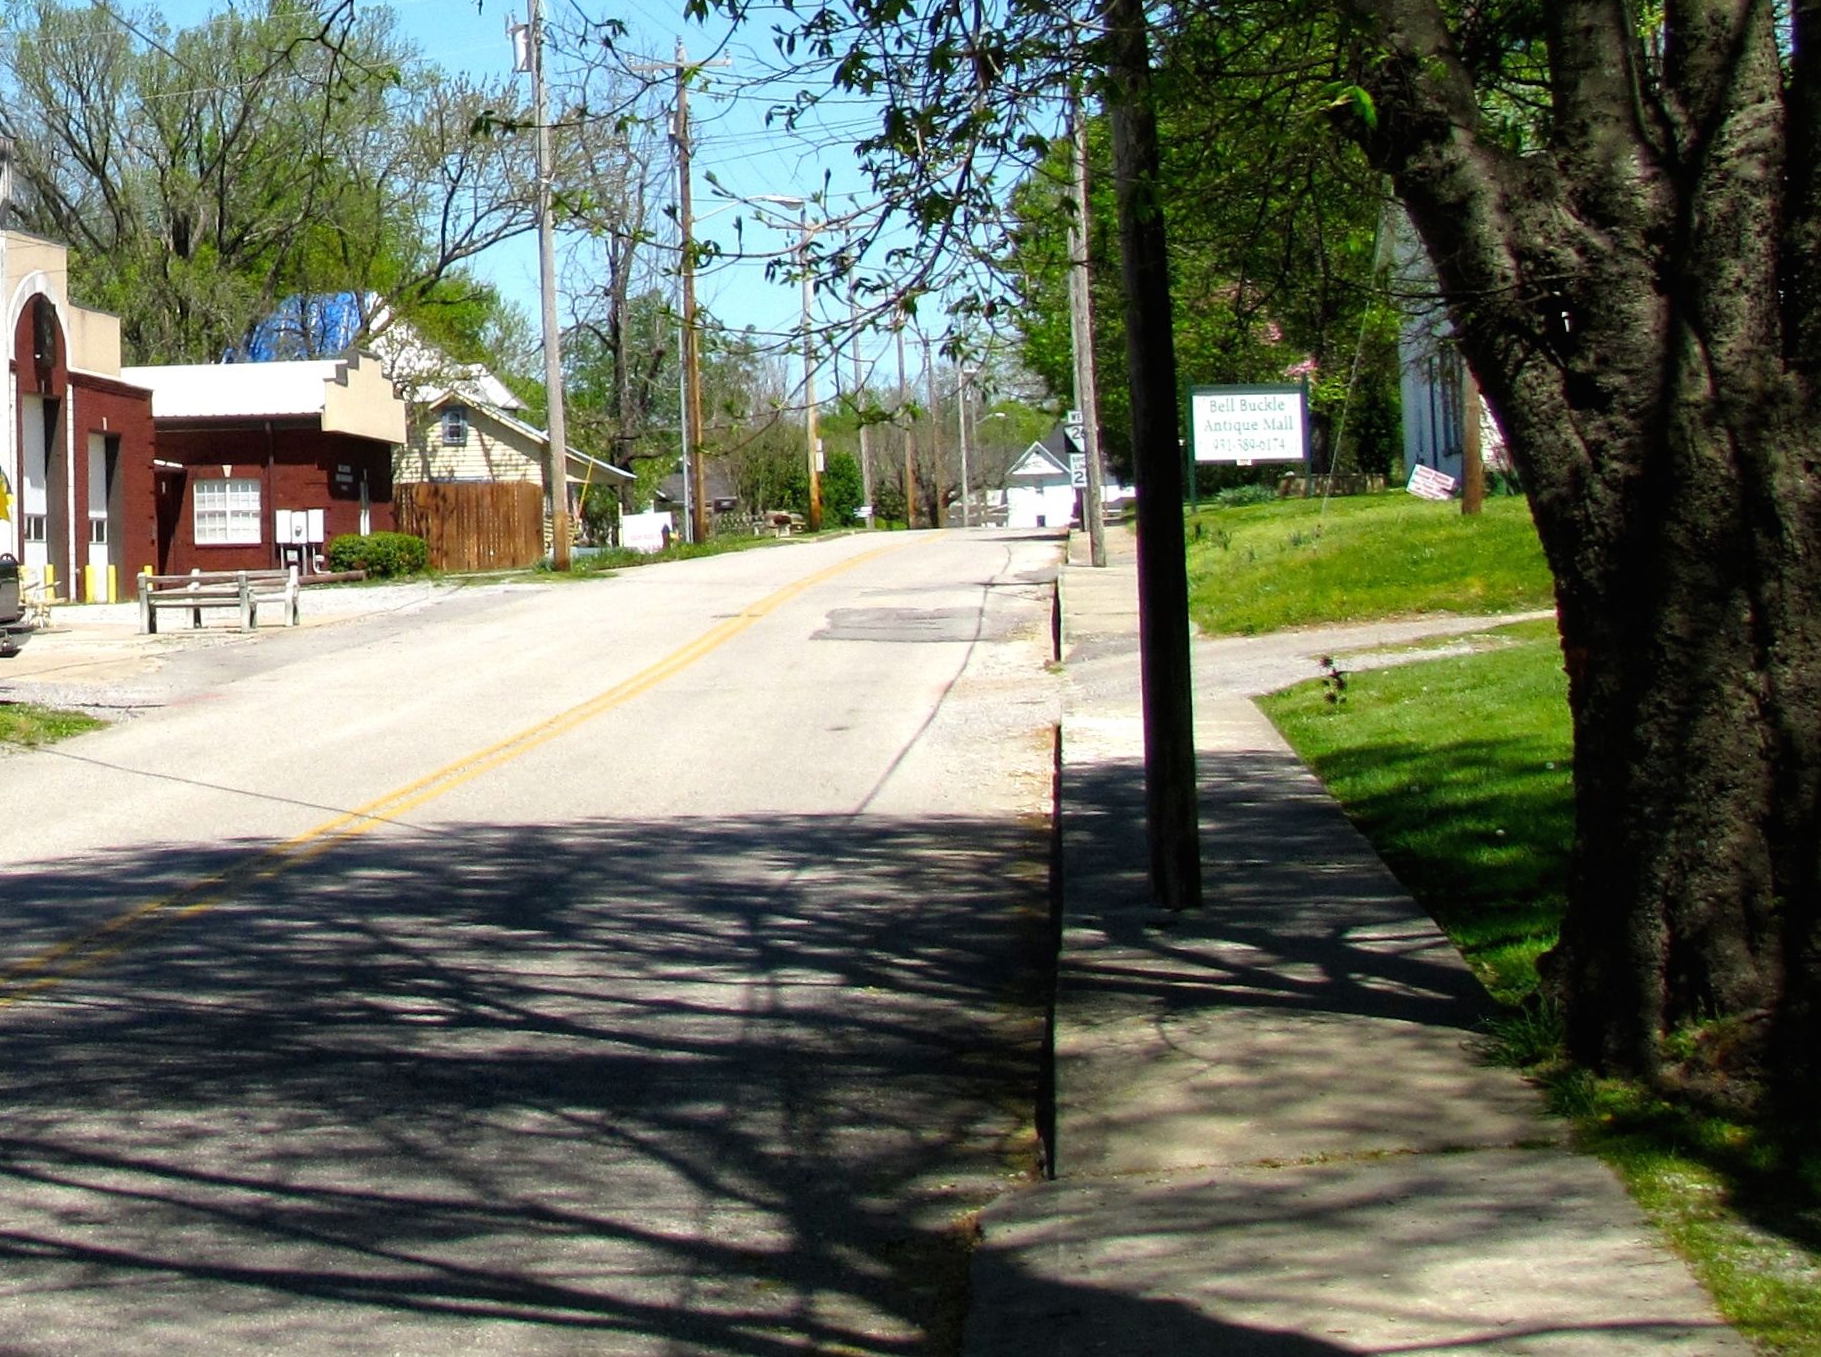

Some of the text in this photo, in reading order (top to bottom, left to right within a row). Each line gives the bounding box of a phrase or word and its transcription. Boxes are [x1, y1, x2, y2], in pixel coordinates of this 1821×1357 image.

[1210, 396, 1285, 413] Bell Buckle
[1070, 413, 1083, 422] WE
[1204, 415, 1294, 436] Antique Mall
